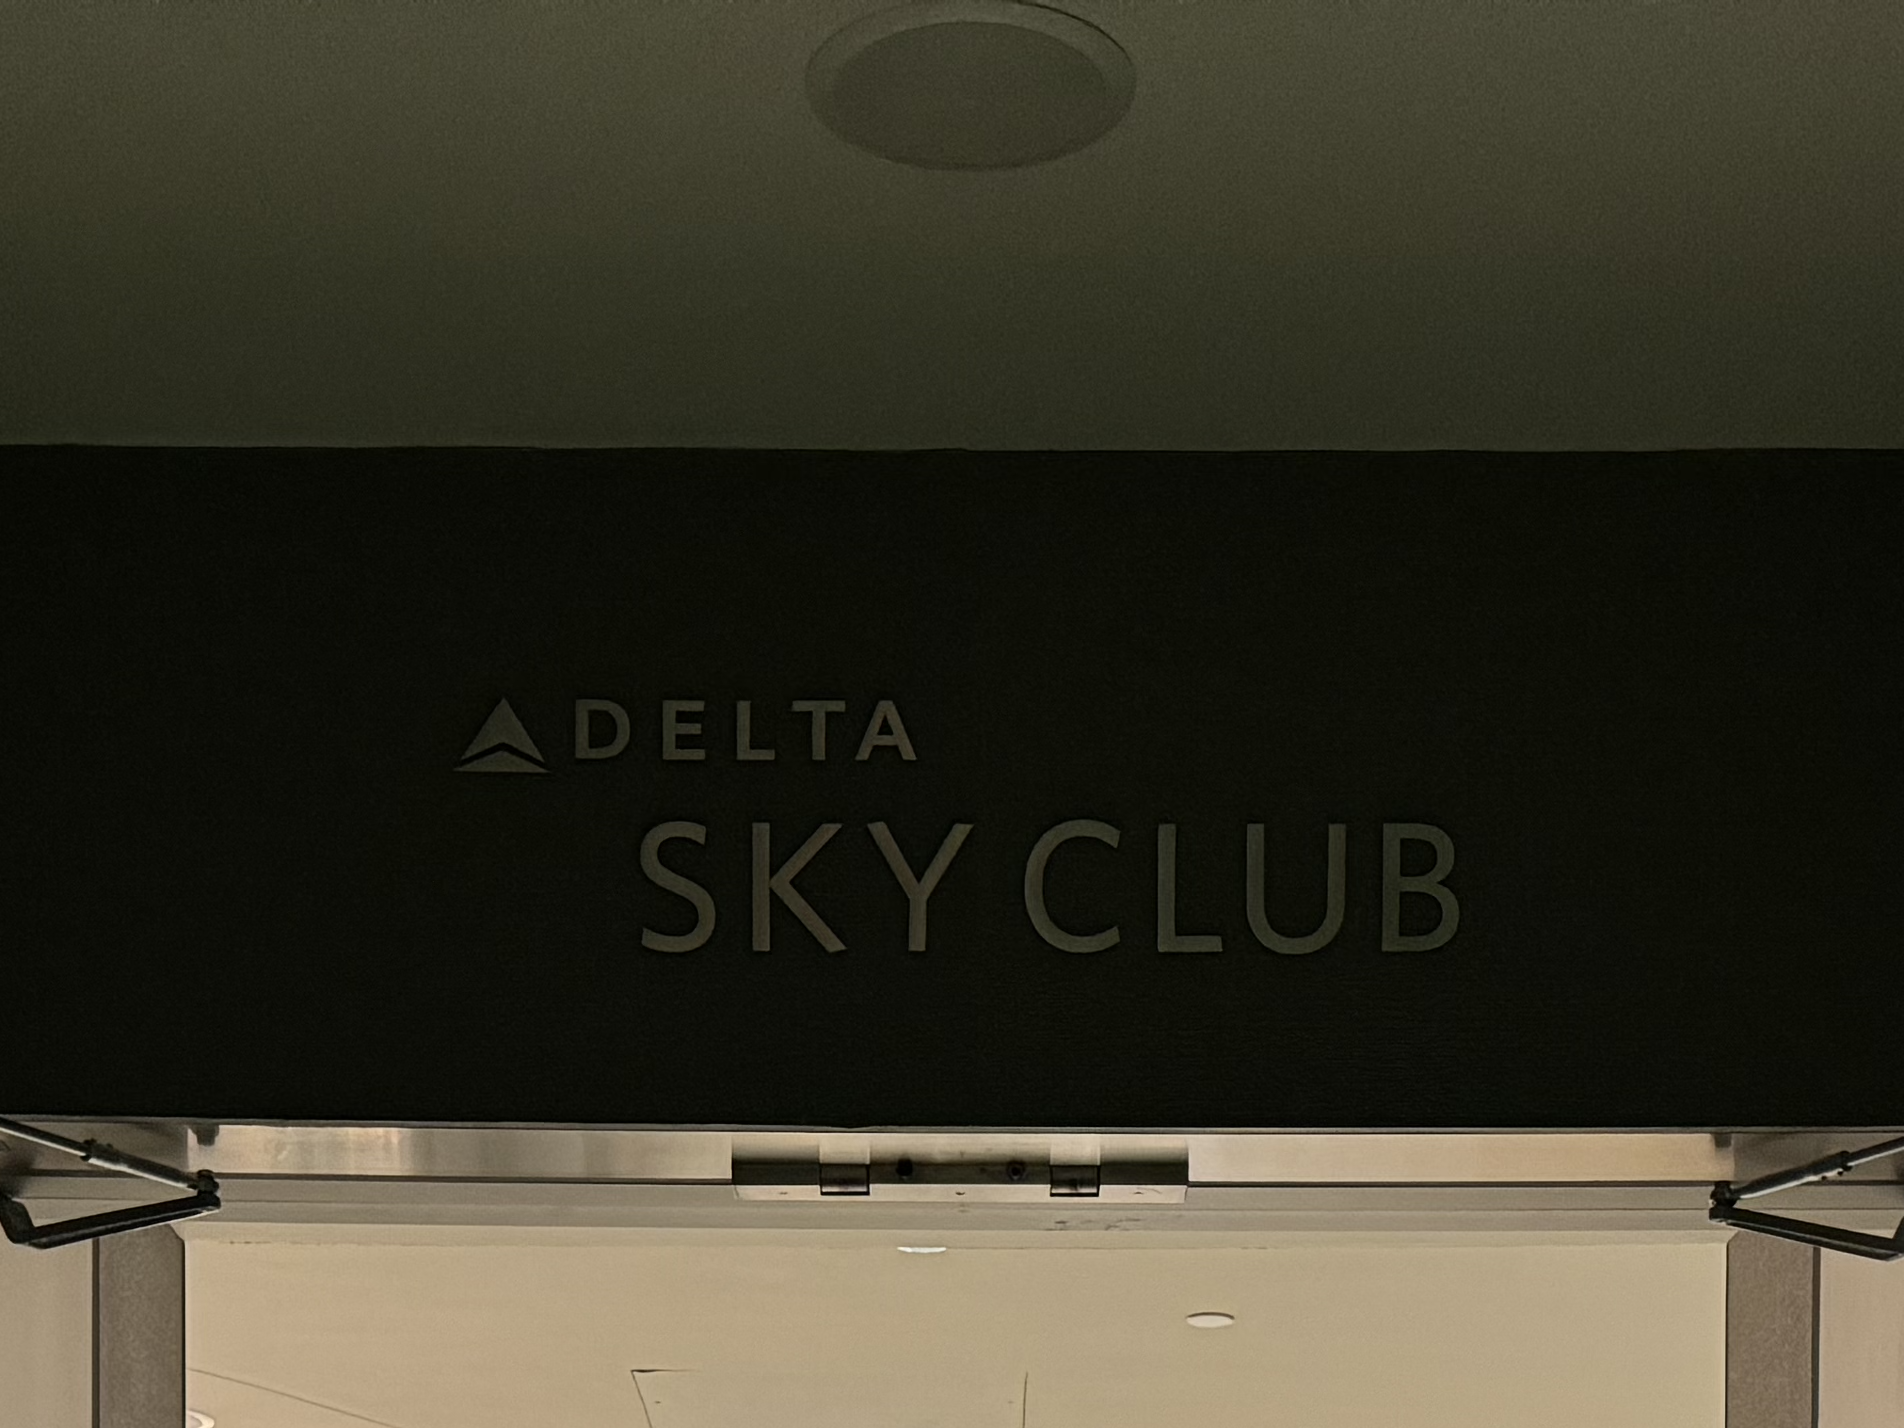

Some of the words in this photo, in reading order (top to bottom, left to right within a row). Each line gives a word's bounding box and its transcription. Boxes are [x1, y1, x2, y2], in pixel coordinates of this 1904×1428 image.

[574, 698, 919, 762] DELTA
[639, 819, 975, 955] SKY
[1022, 819, 1463, 956] CLUB
